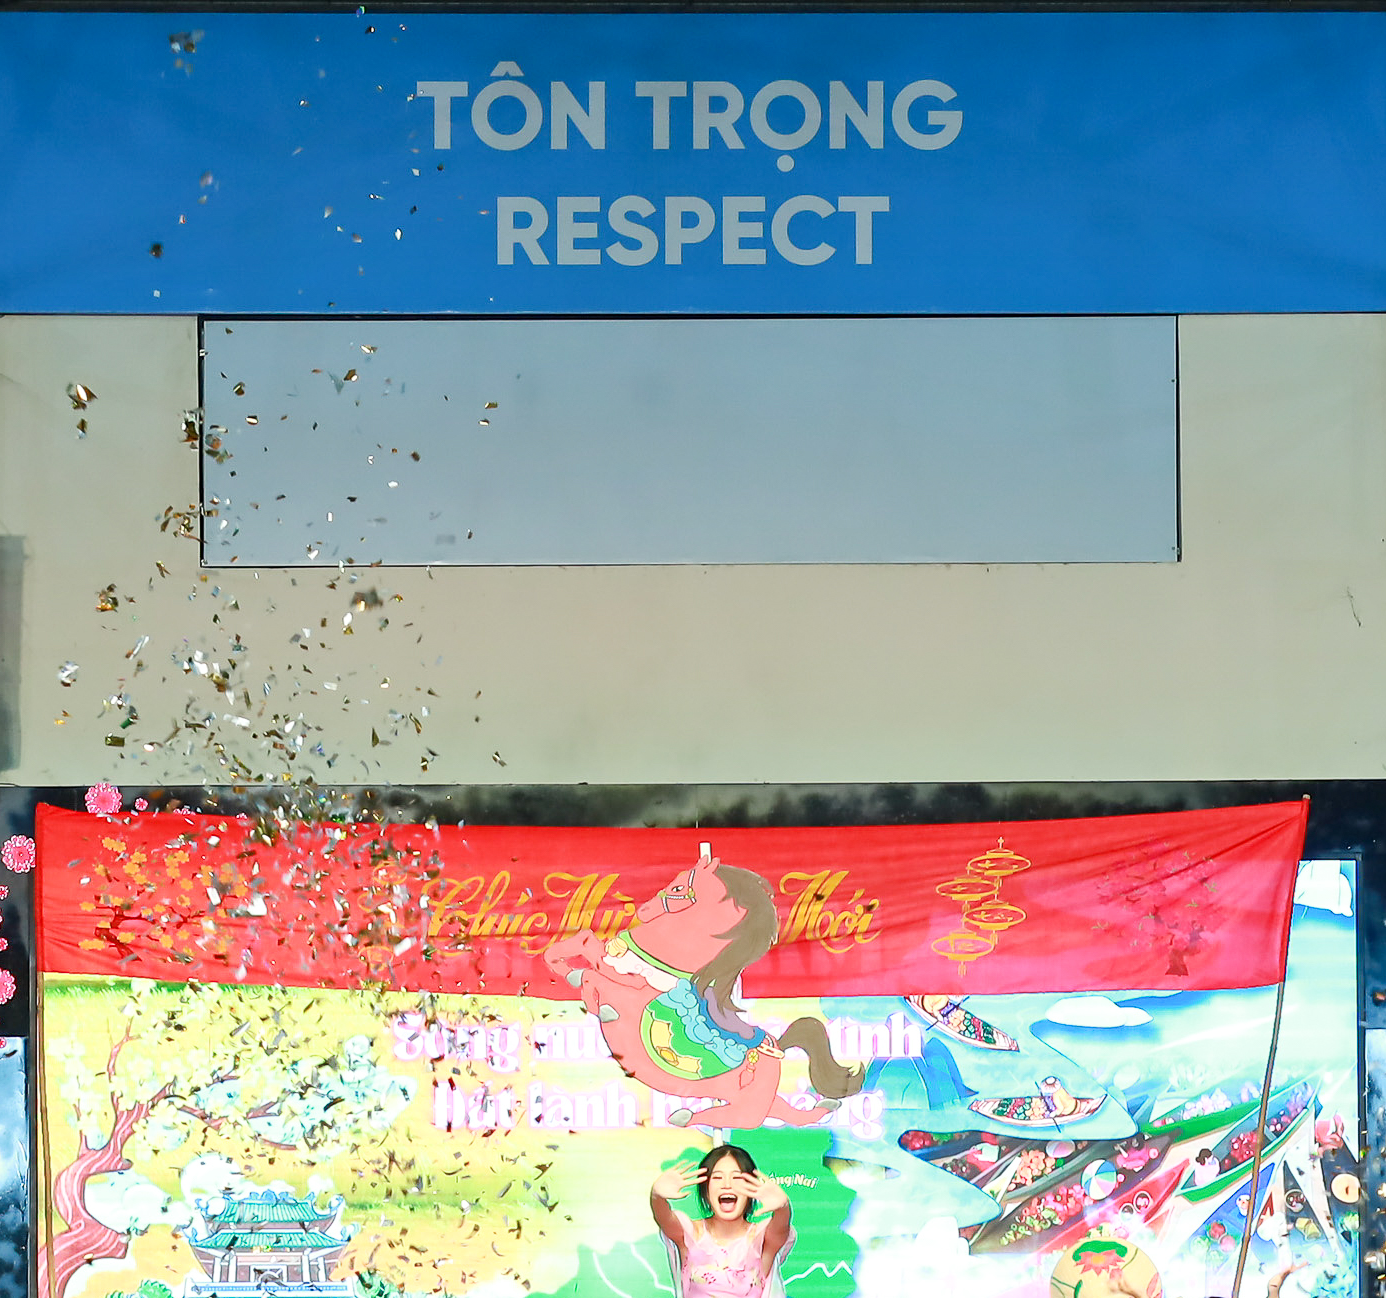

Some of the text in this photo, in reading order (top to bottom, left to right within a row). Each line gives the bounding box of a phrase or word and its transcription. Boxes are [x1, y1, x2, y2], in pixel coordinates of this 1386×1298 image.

[416, 60, 963, 172] TÔN TRỌNG
[496, 194, 890, 266] RESPECT
[421, 869, 884, 956] Chúc Mừ Mới
[529, 1080, 637, 1128] lành
